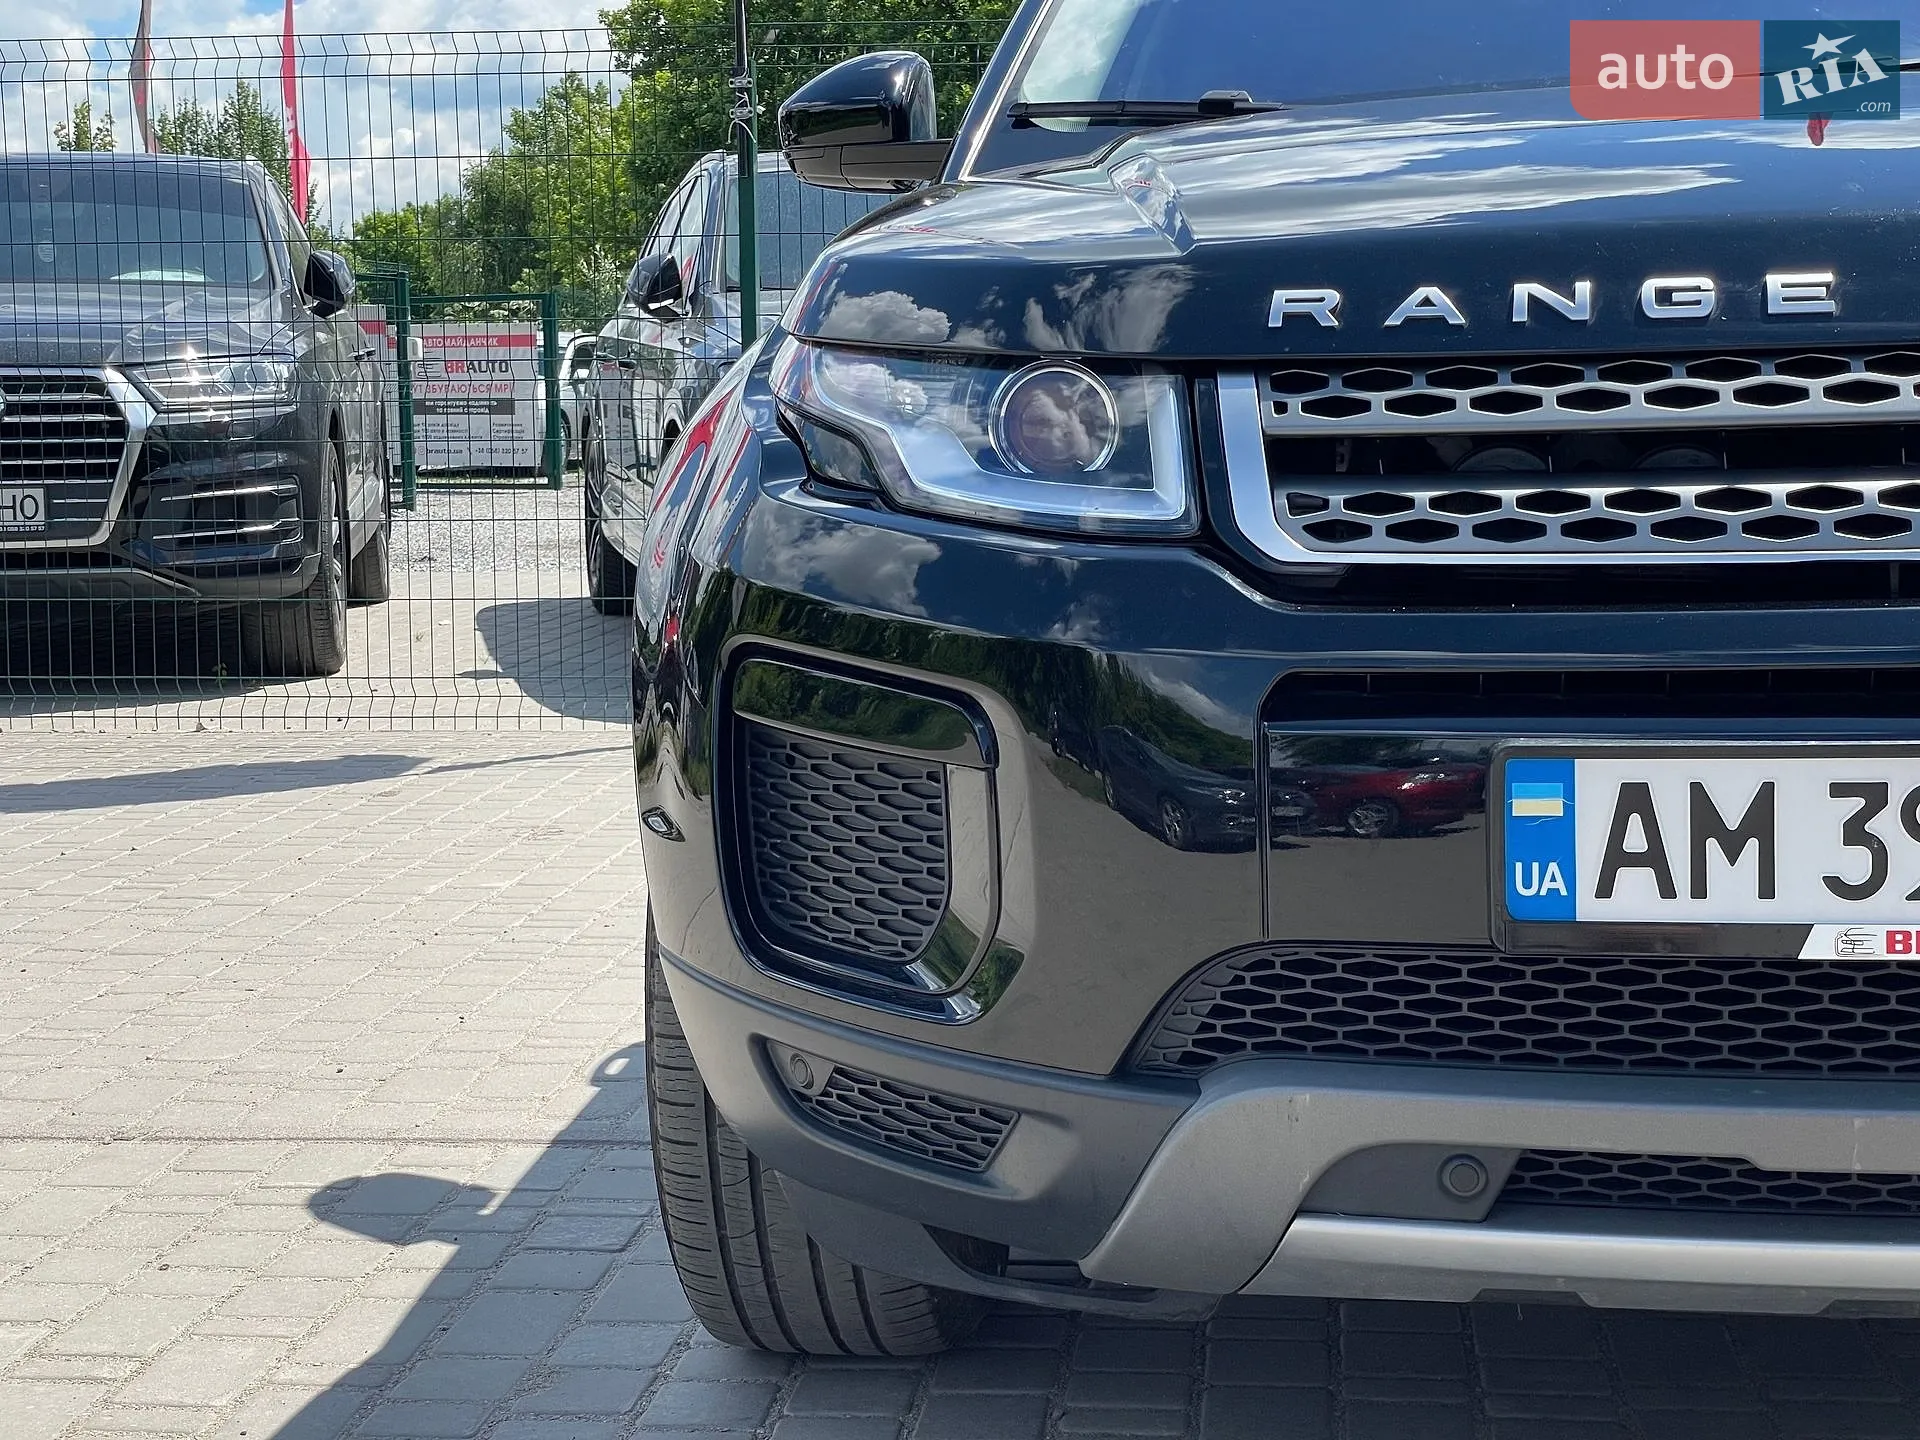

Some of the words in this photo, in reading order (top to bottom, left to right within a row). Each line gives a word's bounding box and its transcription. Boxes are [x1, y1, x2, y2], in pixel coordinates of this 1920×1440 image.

[1267, 272, 1837, 328] RANGE
[446, 360, 509, 374] BRAUTO
[412, 383, 423, 394] УТ
[494, 383, 515, 394] МРІ
[1594, 781, 1777, 899] AM
[1515, 861, 1568, 897] UA
[1886, 930, 1920, 954] B
